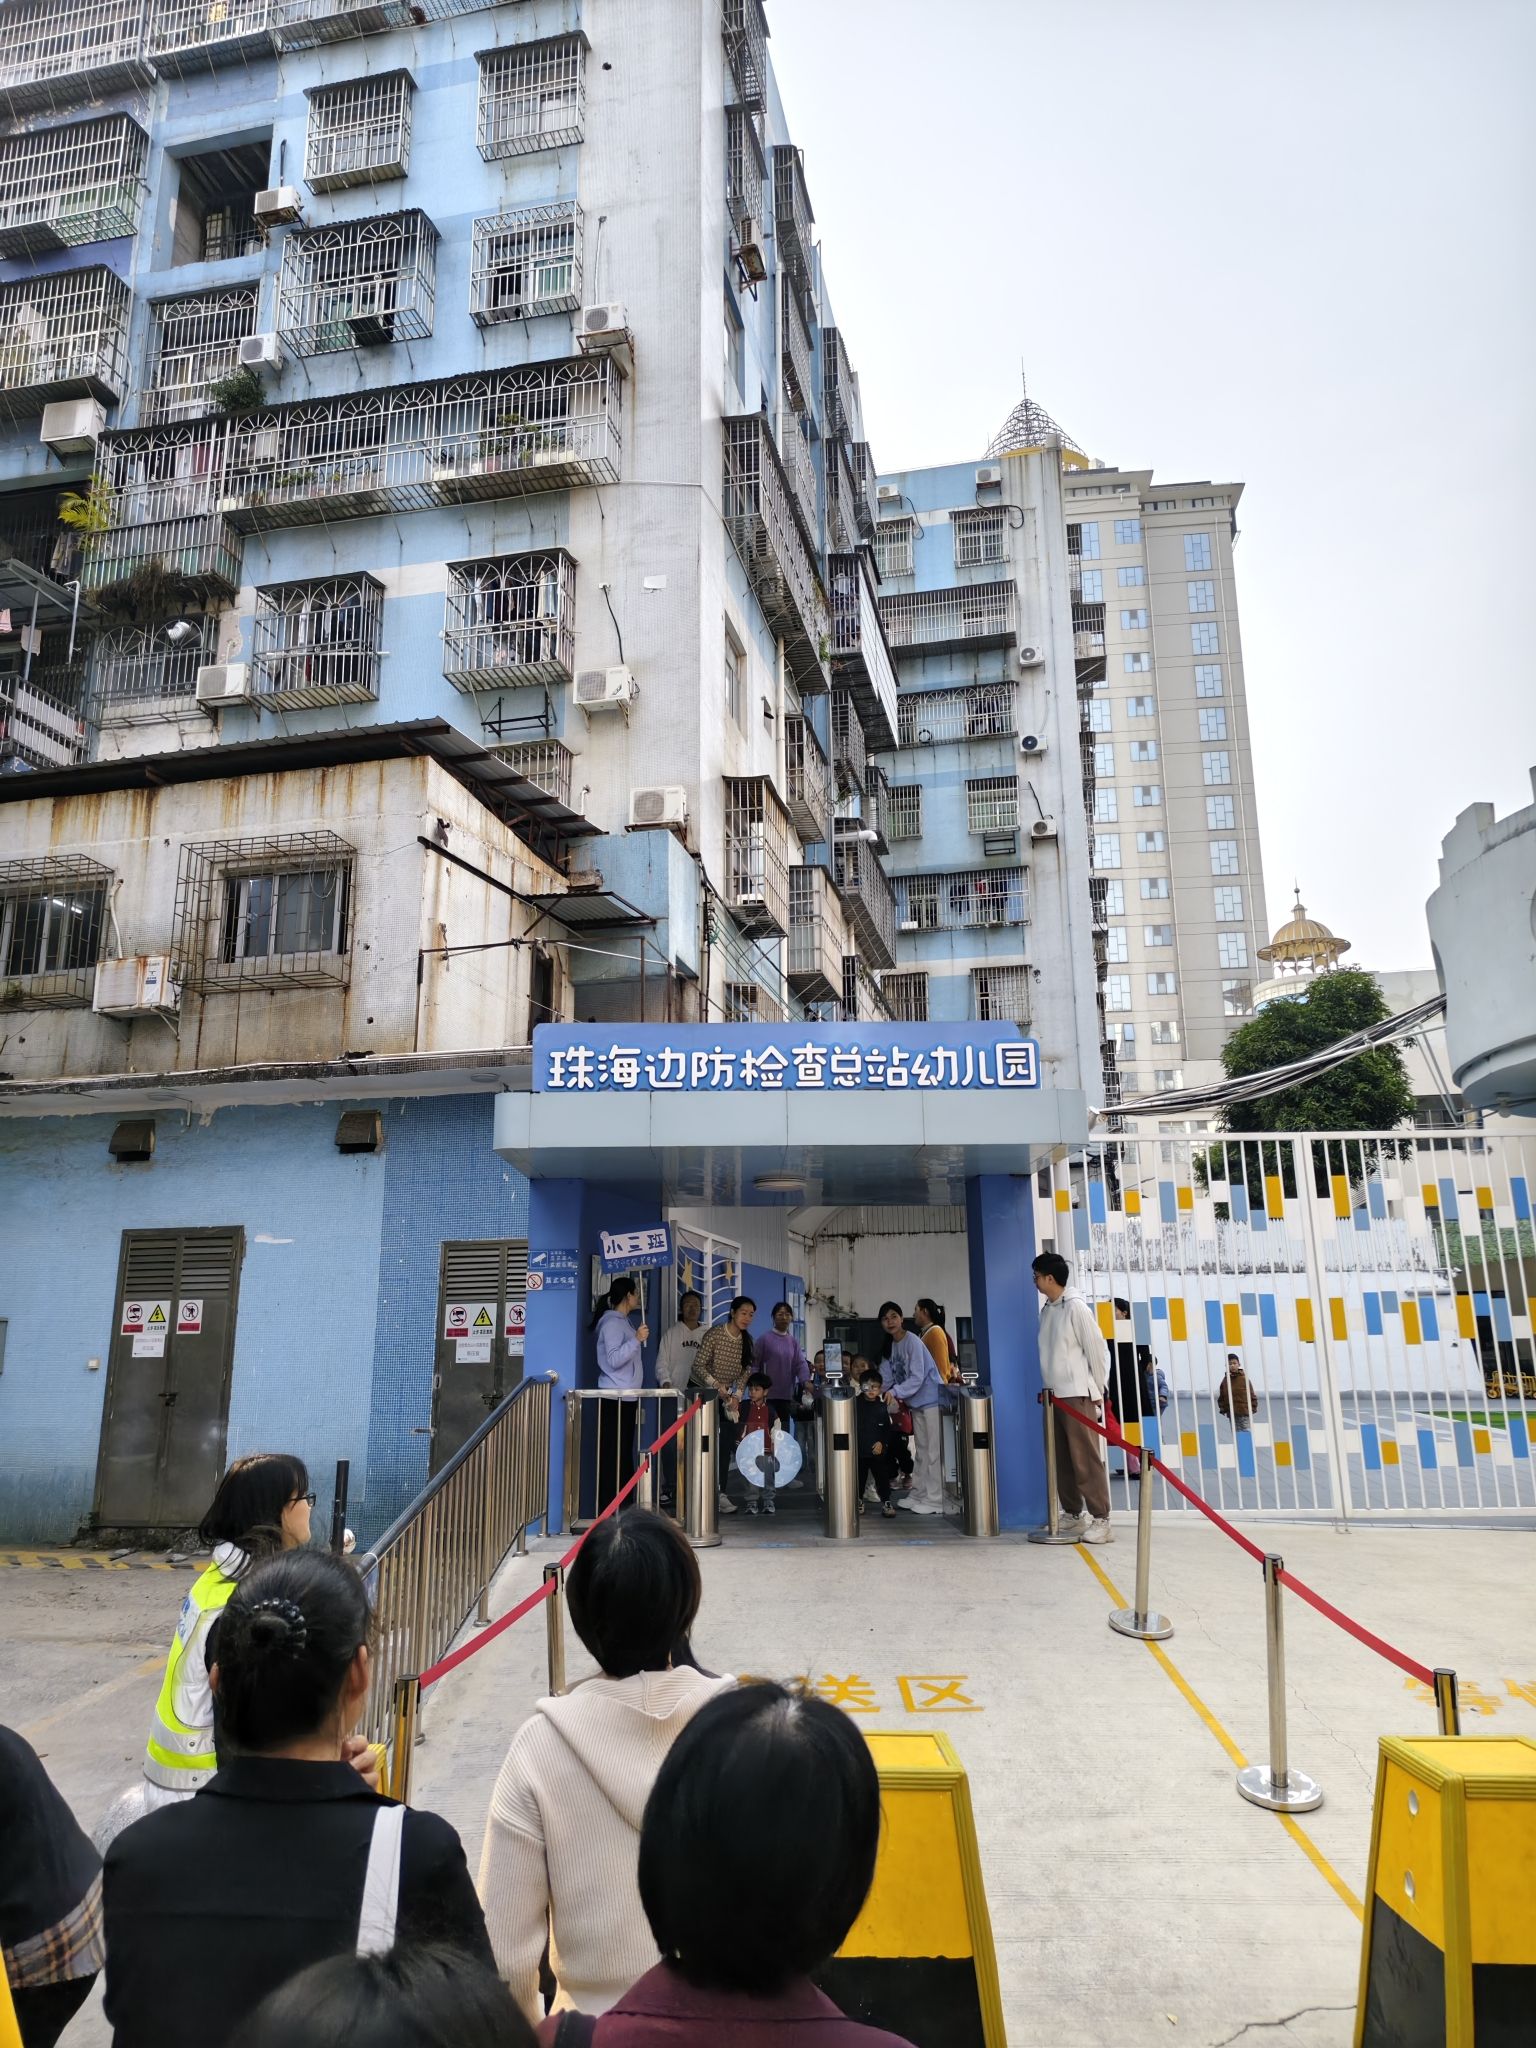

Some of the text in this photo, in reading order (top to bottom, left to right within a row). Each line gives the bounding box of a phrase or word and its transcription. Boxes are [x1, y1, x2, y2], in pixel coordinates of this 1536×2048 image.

[547, 1041, 1038, 1089] 珠海边防检查总站幼儿园
[737, 1674, 985, 1713] 送区
